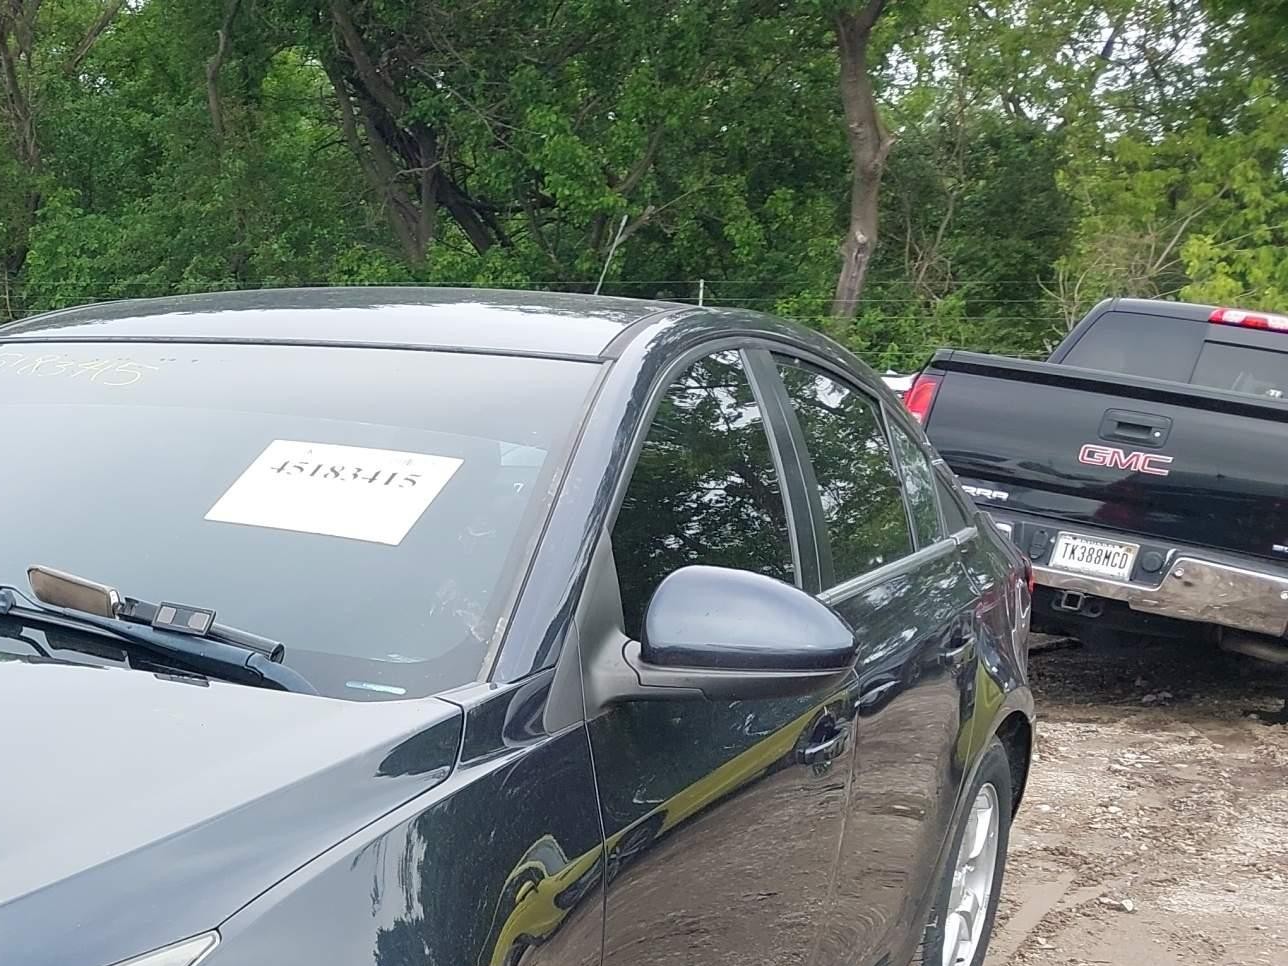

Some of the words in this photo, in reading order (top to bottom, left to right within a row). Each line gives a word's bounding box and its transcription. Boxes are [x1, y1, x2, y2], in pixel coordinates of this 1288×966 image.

[269, 459, 423, 489] 45183415
[1078, 443, 1174, 476] GMC
[1062, 543, 1129, 570] TK388MCD
